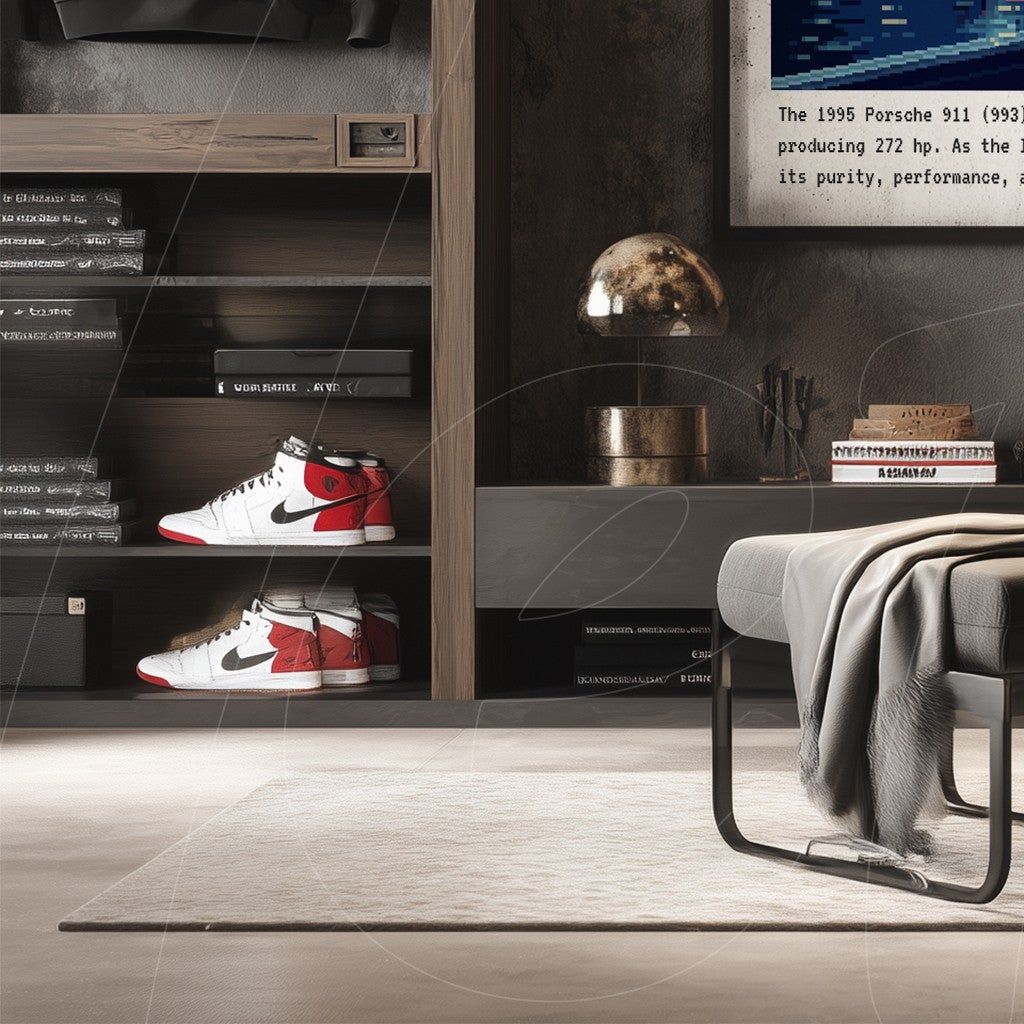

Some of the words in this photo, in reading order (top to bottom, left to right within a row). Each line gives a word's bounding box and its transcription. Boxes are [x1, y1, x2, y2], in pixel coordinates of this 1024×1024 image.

[779, 107, 806, 121] The
[819, 107, 854, 121] 1995
[866, 107, 931, 121] Porsche
[943, 108, 969, 121] 911
[778, 138, 865, 156] producing
[876, 138, 902, 152] 272
[914, 138, 940, 156] hp.
[952, 138, 970, 153] As
[982, 139, 1009, 153] the
[780, 169, 806, 183] its
[817, 169, 881, 187] purity,
[894, 169, 1006, 188] performance,
